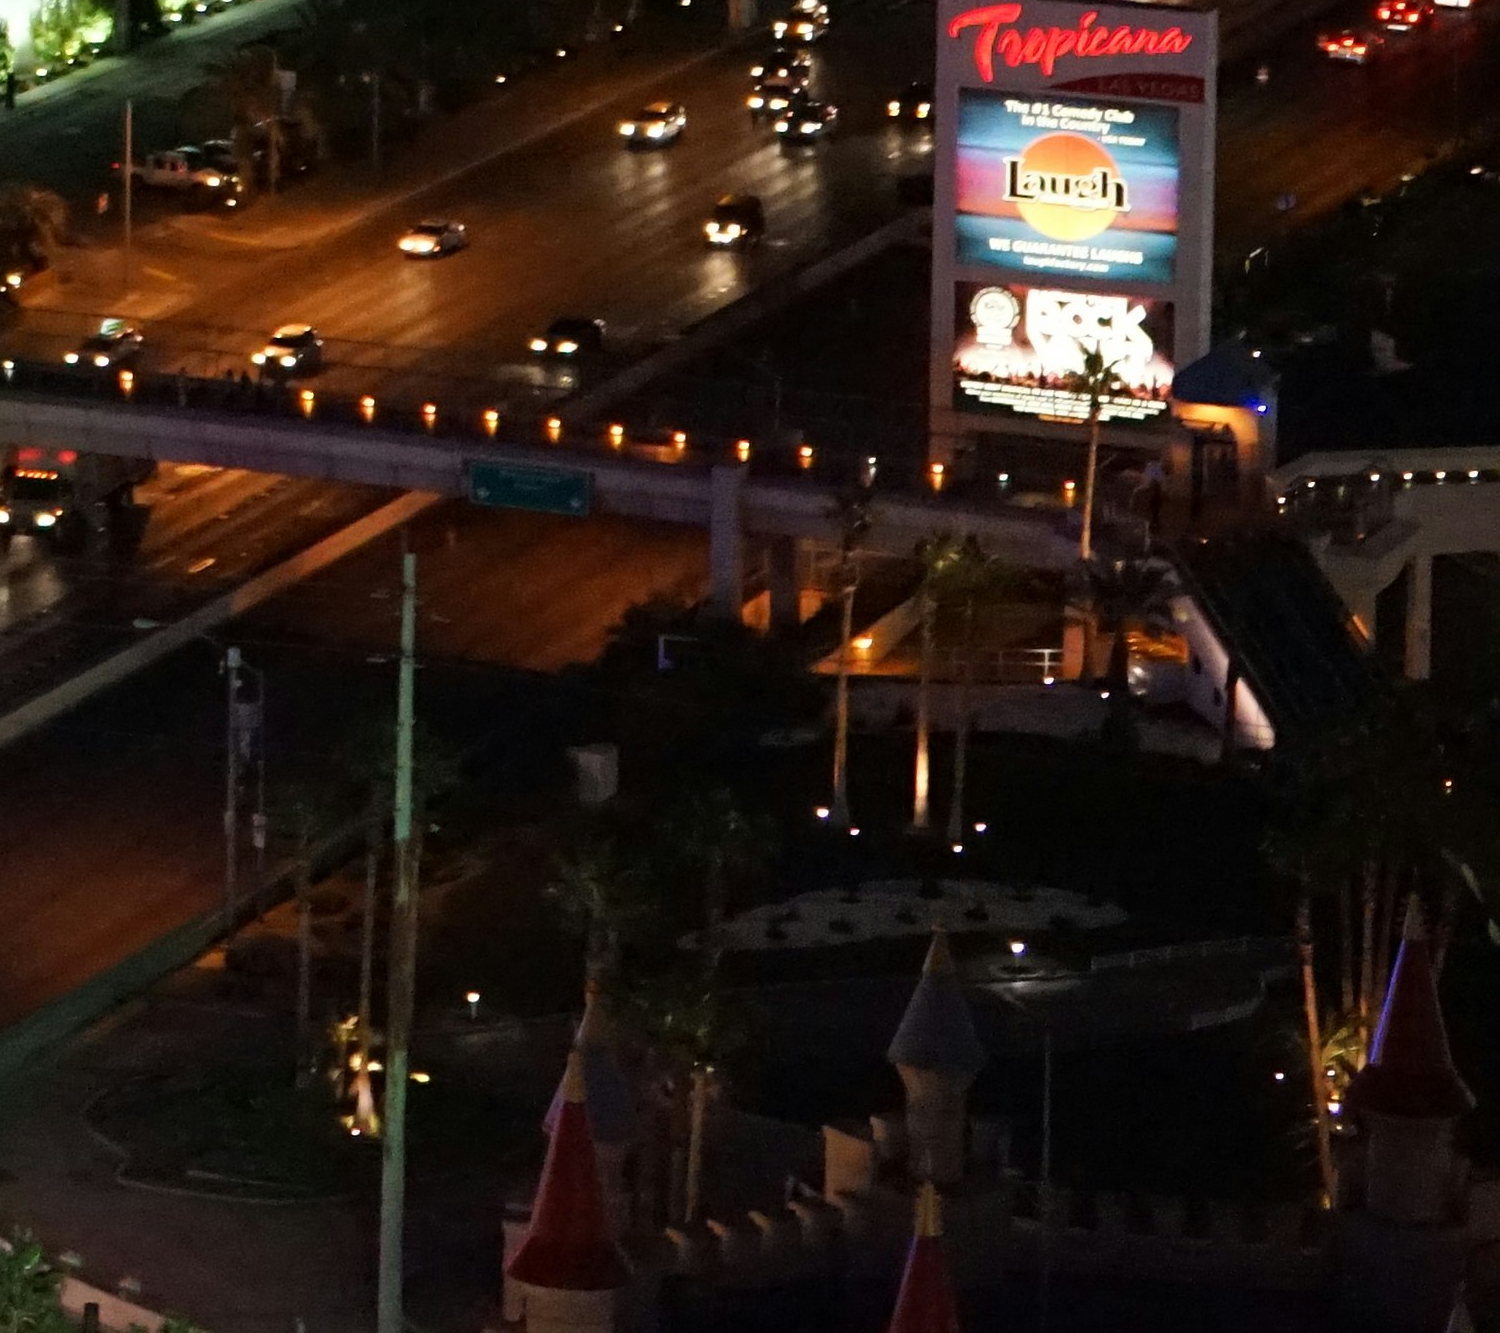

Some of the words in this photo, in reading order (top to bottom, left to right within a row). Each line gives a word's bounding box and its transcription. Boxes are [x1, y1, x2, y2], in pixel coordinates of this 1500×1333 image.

[948, 2, 1194, 84] Tropicana
[1004, 99, 1030, 115] The
[1051, 103, 1103, 123] Comedy
[1104, 108, 1136, 124] Club
[1059, 117, 1112, 136] Country
[1002, 155, 1132, 213] Laugh
